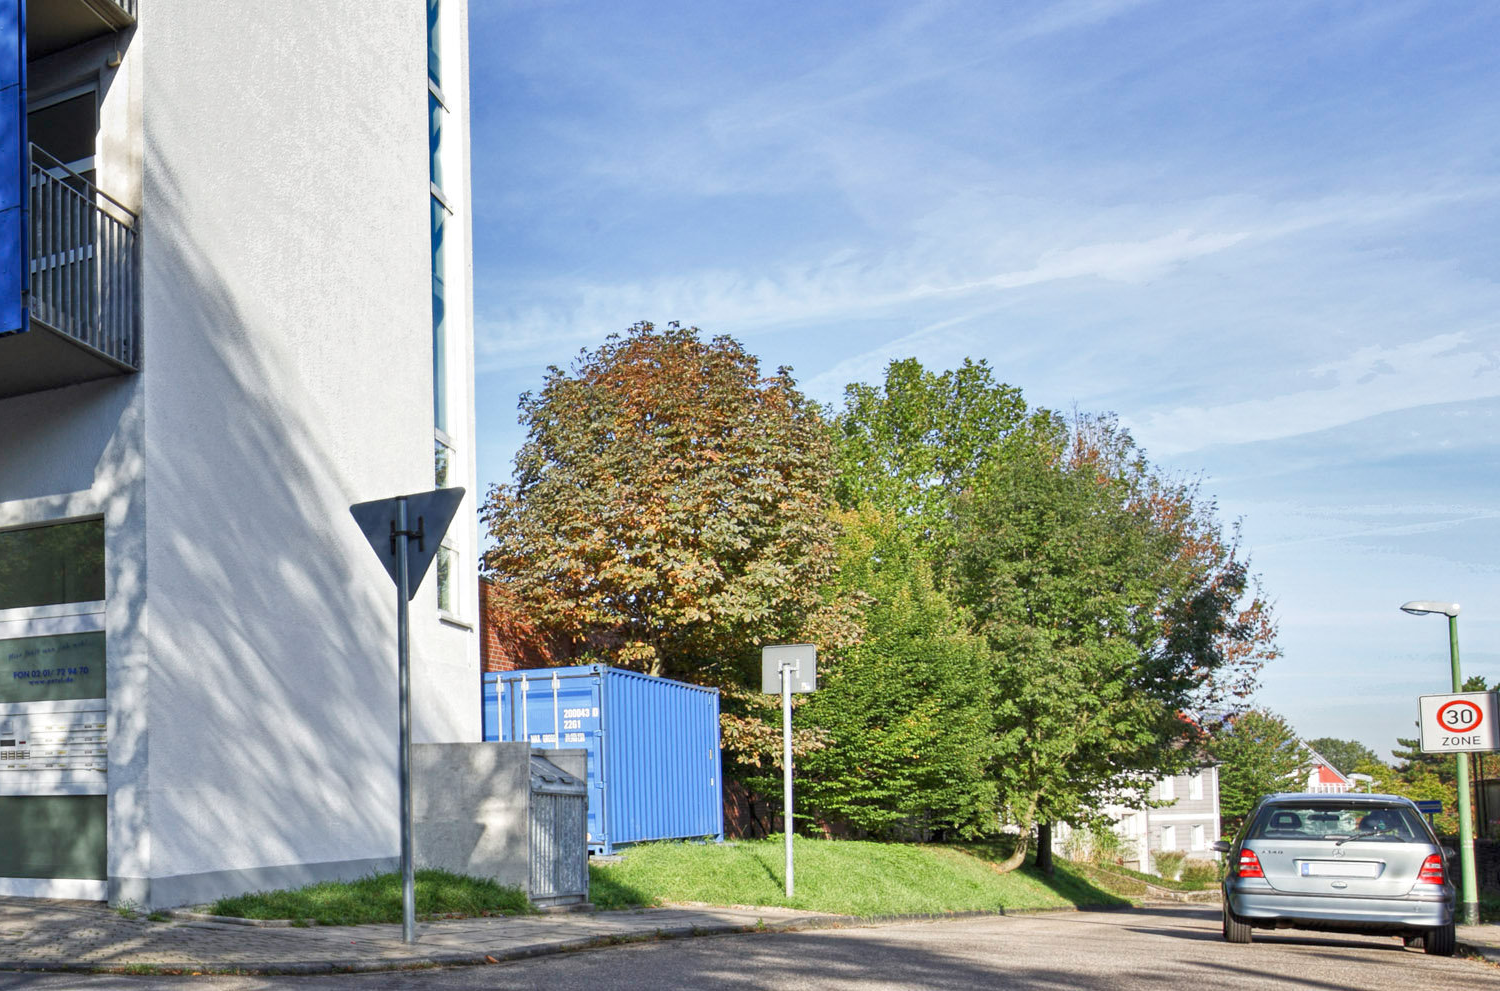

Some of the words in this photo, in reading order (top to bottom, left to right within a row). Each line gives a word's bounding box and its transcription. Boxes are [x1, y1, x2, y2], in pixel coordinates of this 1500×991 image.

[13, 670, 30, 679] FON
[31, 669, 41, 678] 02
[57, 668, 65, 676] 72
[68, 667, 77, 675] 94
[79, 666, 89, 674] 70
[1446, 709, 1473, 725] 30
[1442, 736, 1481, 746] ZONE
